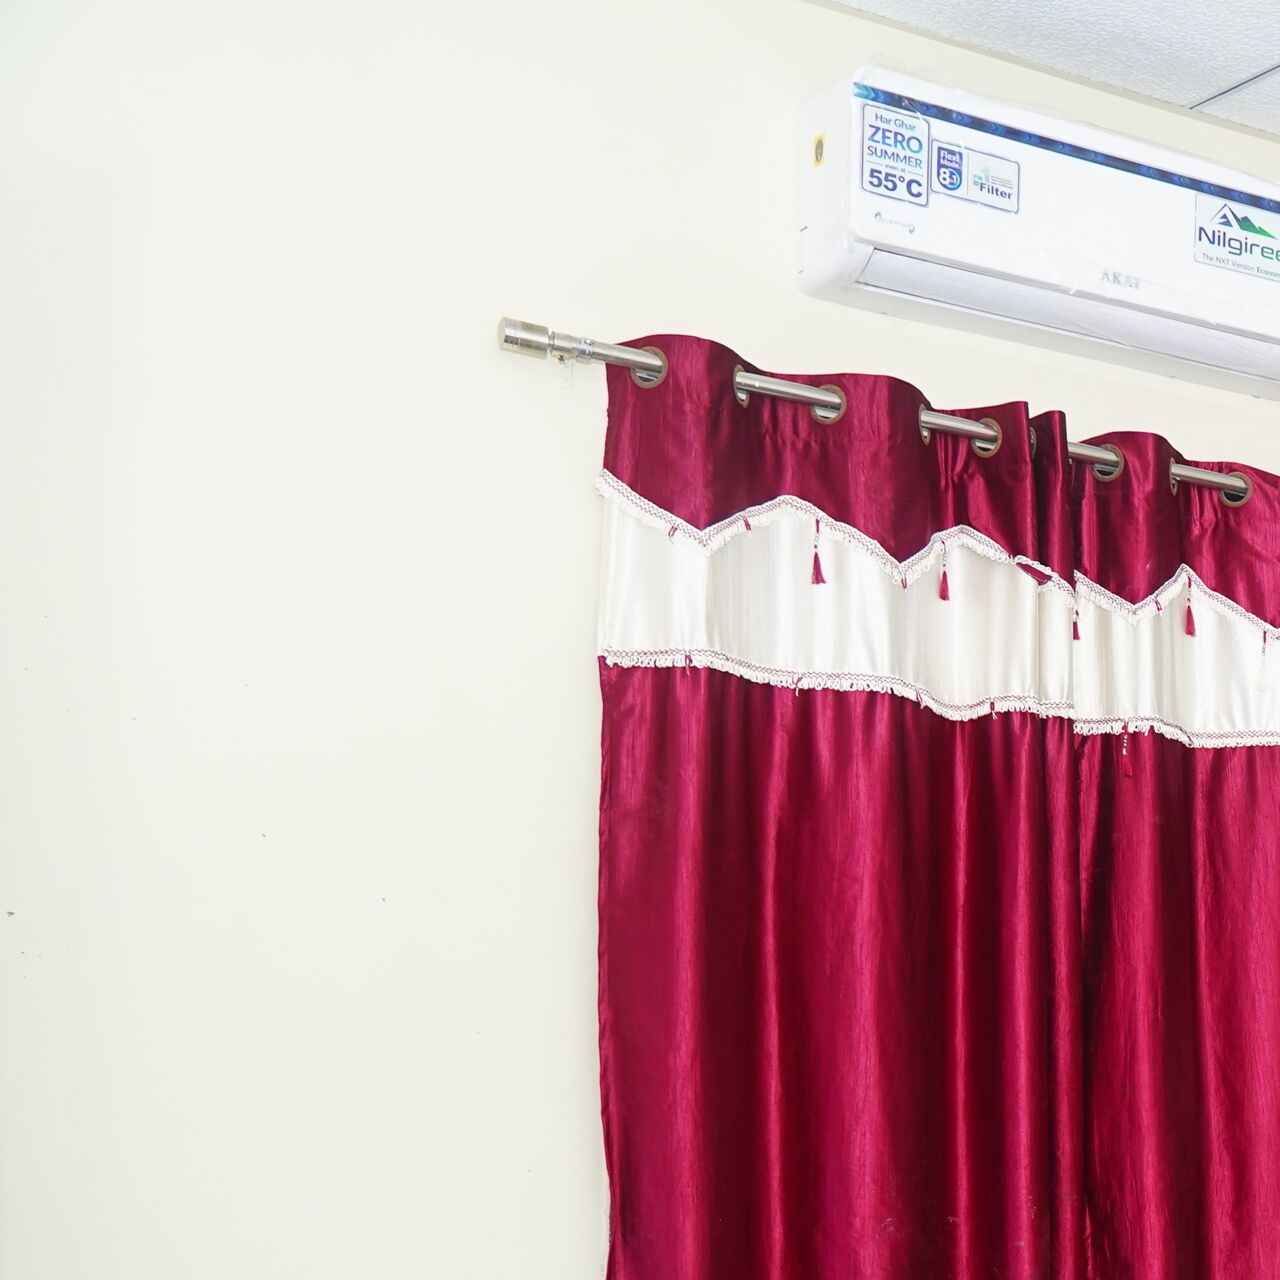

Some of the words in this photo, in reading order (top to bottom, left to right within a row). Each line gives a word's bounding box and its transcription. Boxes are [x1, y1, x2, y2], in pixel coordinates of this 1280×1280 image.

[875, 113, 892, 125] Har
[894, 118, 916, 132] Ghar
[868, 124, 923, 154] ZERO
[867, 146, 923, 169] SUMMER
[868, 168, 923, 198] 55°C
[979, 182, 1013, 200] Filter
[1202, 252, 1214, 263] The
[1215, 256, 1230, 267] NXT
[1231, 260, 1256, 273] Version
